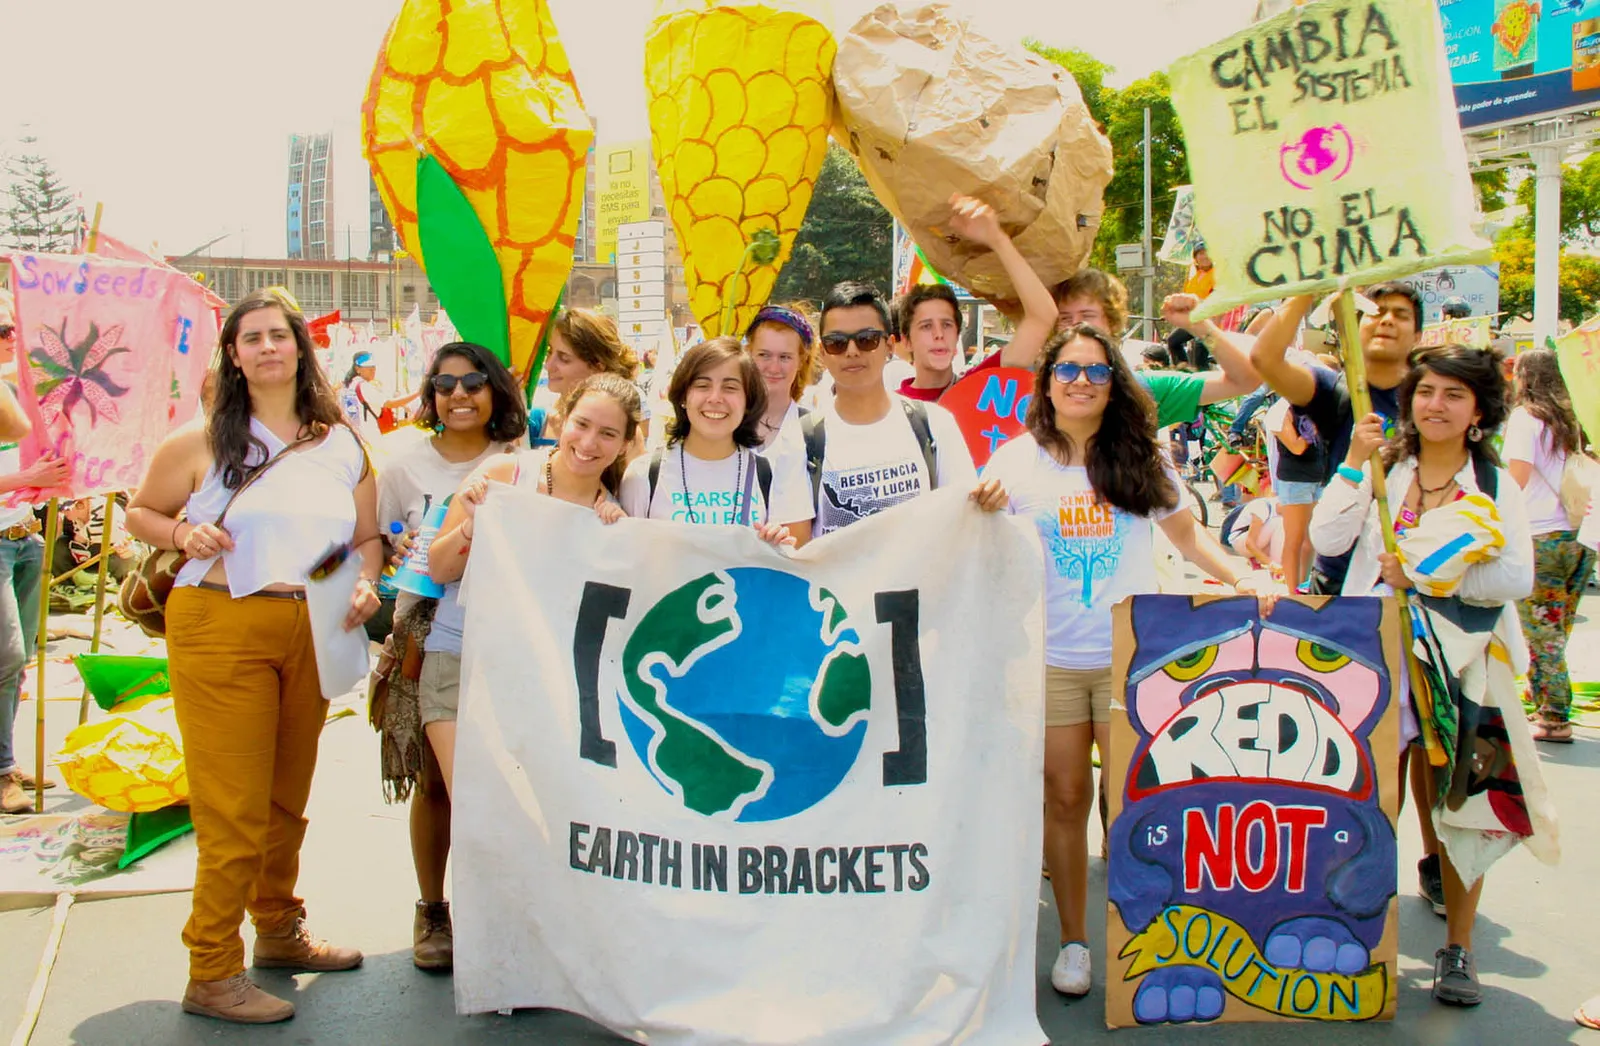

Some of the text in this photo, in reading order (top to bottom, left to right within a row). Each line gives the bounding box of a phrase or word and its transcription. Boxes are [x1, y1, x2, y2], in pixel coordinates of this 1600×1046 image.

[1210, 2, 1398, 91] CAMBIA
[1229, 55, 1411, 134] EL SISTEMA
[1471, 100, 1492, 112] poder
[1493, 97, 1503, 106] de
[601, 190, 639, 202] necesitas
[619, 180, 631, 188] no
[600, 201, 640, 213] SMS para
[1263, 187, 1394, 243] NO EL
[1246, 206, 1427, 287] CLIMA
[18, 255, 157, 299] Sow Seeds
[840, 462, 918, 488] RESISTENCIA
[873, 477, 920, 498] Y LUCHA
[671, 491, 759, 507] PEARSON
[1059, 505, 1113, 526] NACE
[1148, 683, 1358, 792] REDD
[569, 821, 930, 894] EARTH IN BRACKETS
[1148, 825, 1168, 846] is
[1183, 800, 1327, 893] NOT
[1155, 905, 1359, 1014] SOLUTION
